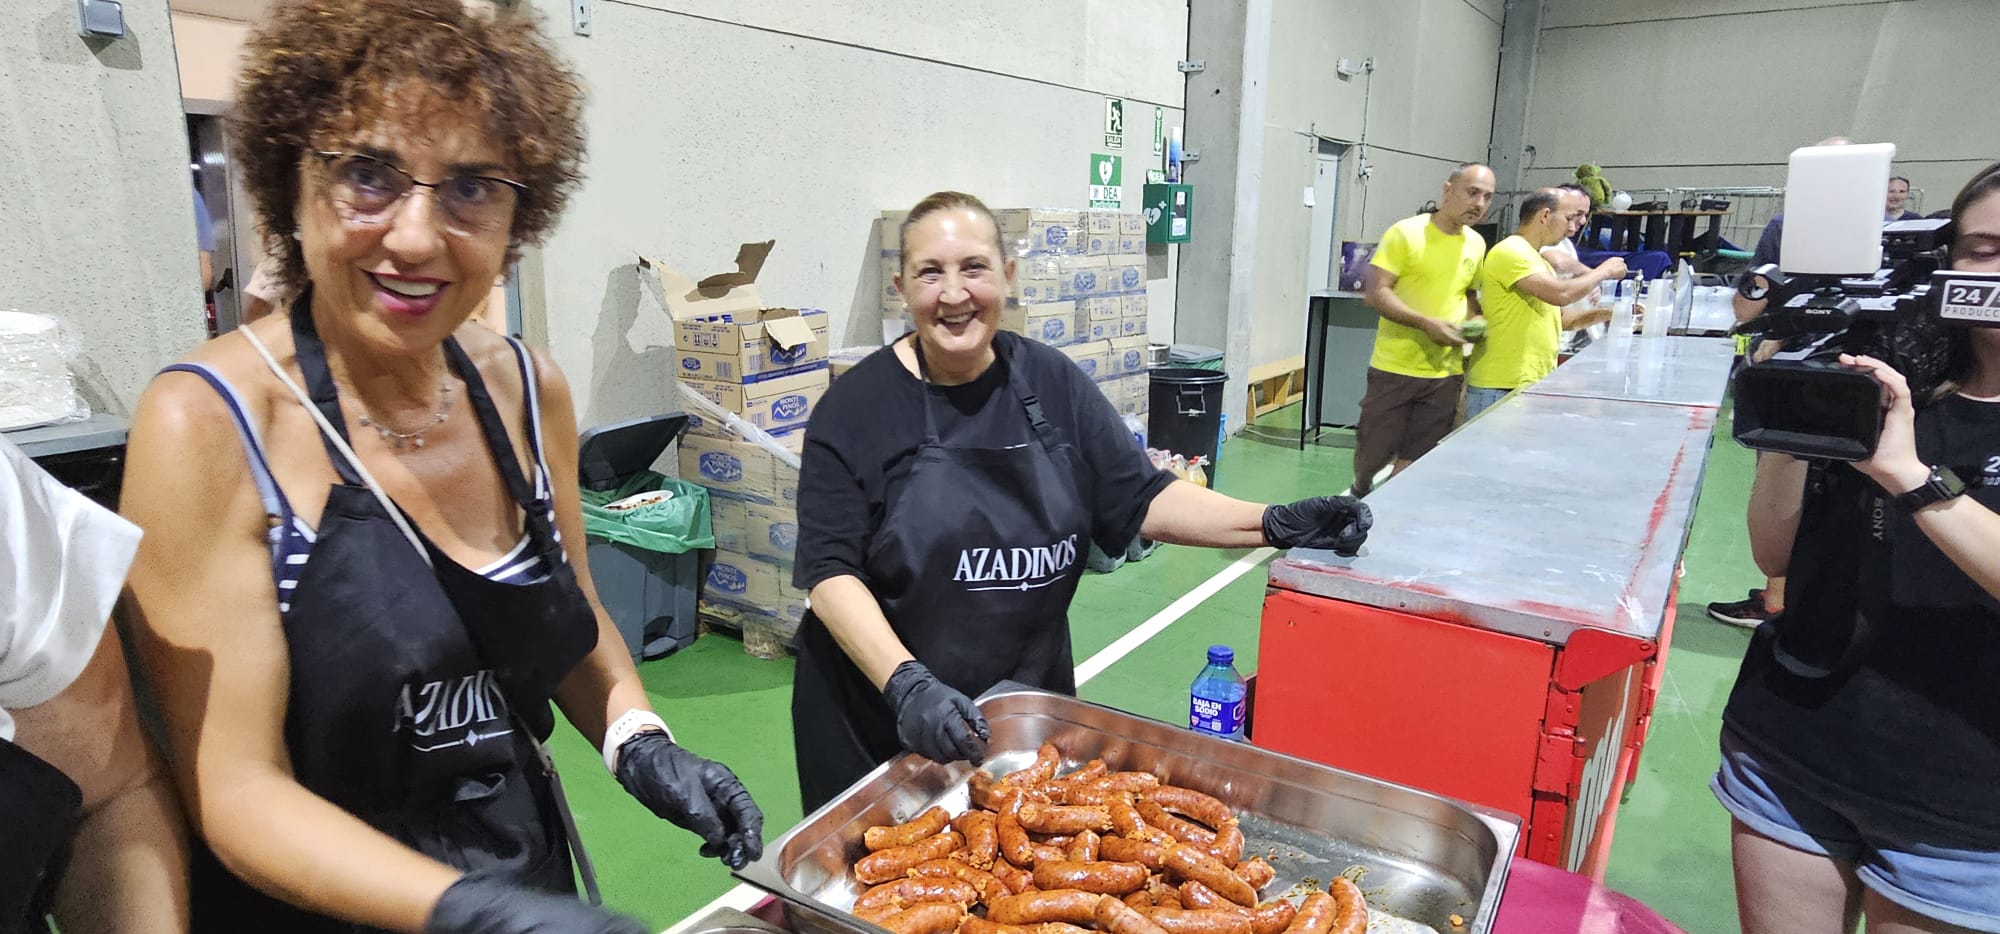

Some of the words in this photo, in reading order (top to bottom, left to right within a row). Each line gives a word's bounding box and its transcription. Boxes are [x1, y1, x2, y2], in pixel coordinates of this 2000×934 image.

[1103, 187, 1118, 199] DEA
[782, 402, 800, 411] PINOS
[709, 453, 731, 462] MONTE
[711, 460, 731, 469] PINOS
[1872, 497, 1885, 540] SONY
[952, 533, 1077, 582] AZADINOS
[715, 564, 737, 573] MONTE
[717, 571, 738, 581] PINOS
[391, 669, 509, 736] AZADIN
[1193, 697, 1210, 708] BAJA
[1210, 702, 1222, 711] EN
[1194, 705, 1218, 717] SODIO
